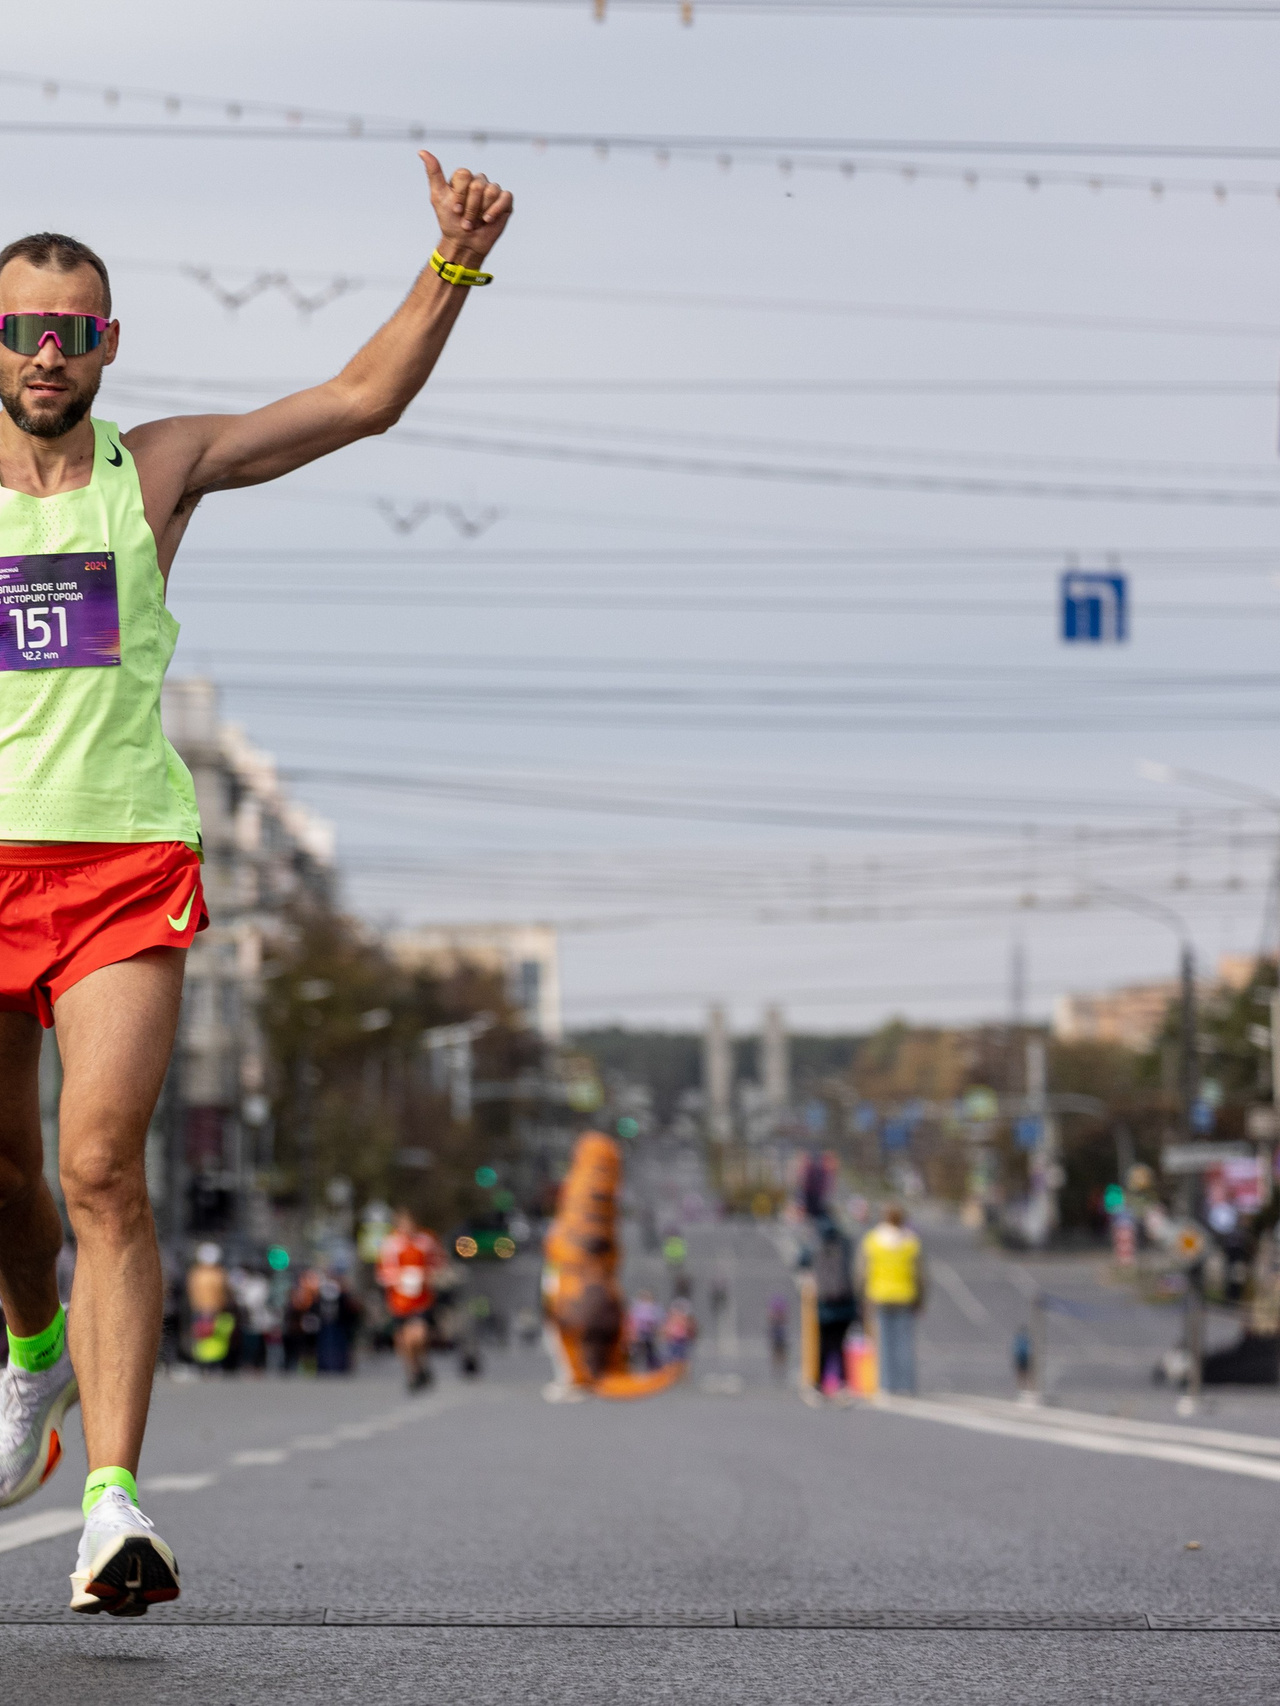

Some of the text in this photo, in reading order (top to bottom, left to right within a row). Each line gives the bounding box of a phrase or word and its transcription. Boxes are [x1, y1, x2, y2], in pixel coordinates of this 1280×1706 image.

[84, 561, 107, 571] 2024
[30, 582, 54, 592] СВОЕ
[56, 581, 77, 591] ИМЯ
[3, 593, 46, 605] ИСТОРИЮ
[47, 592, 83, 602] ГОРОДА
[8, 606, 68, 650] 151
[22, 650, 59, 661] 42,2 км
